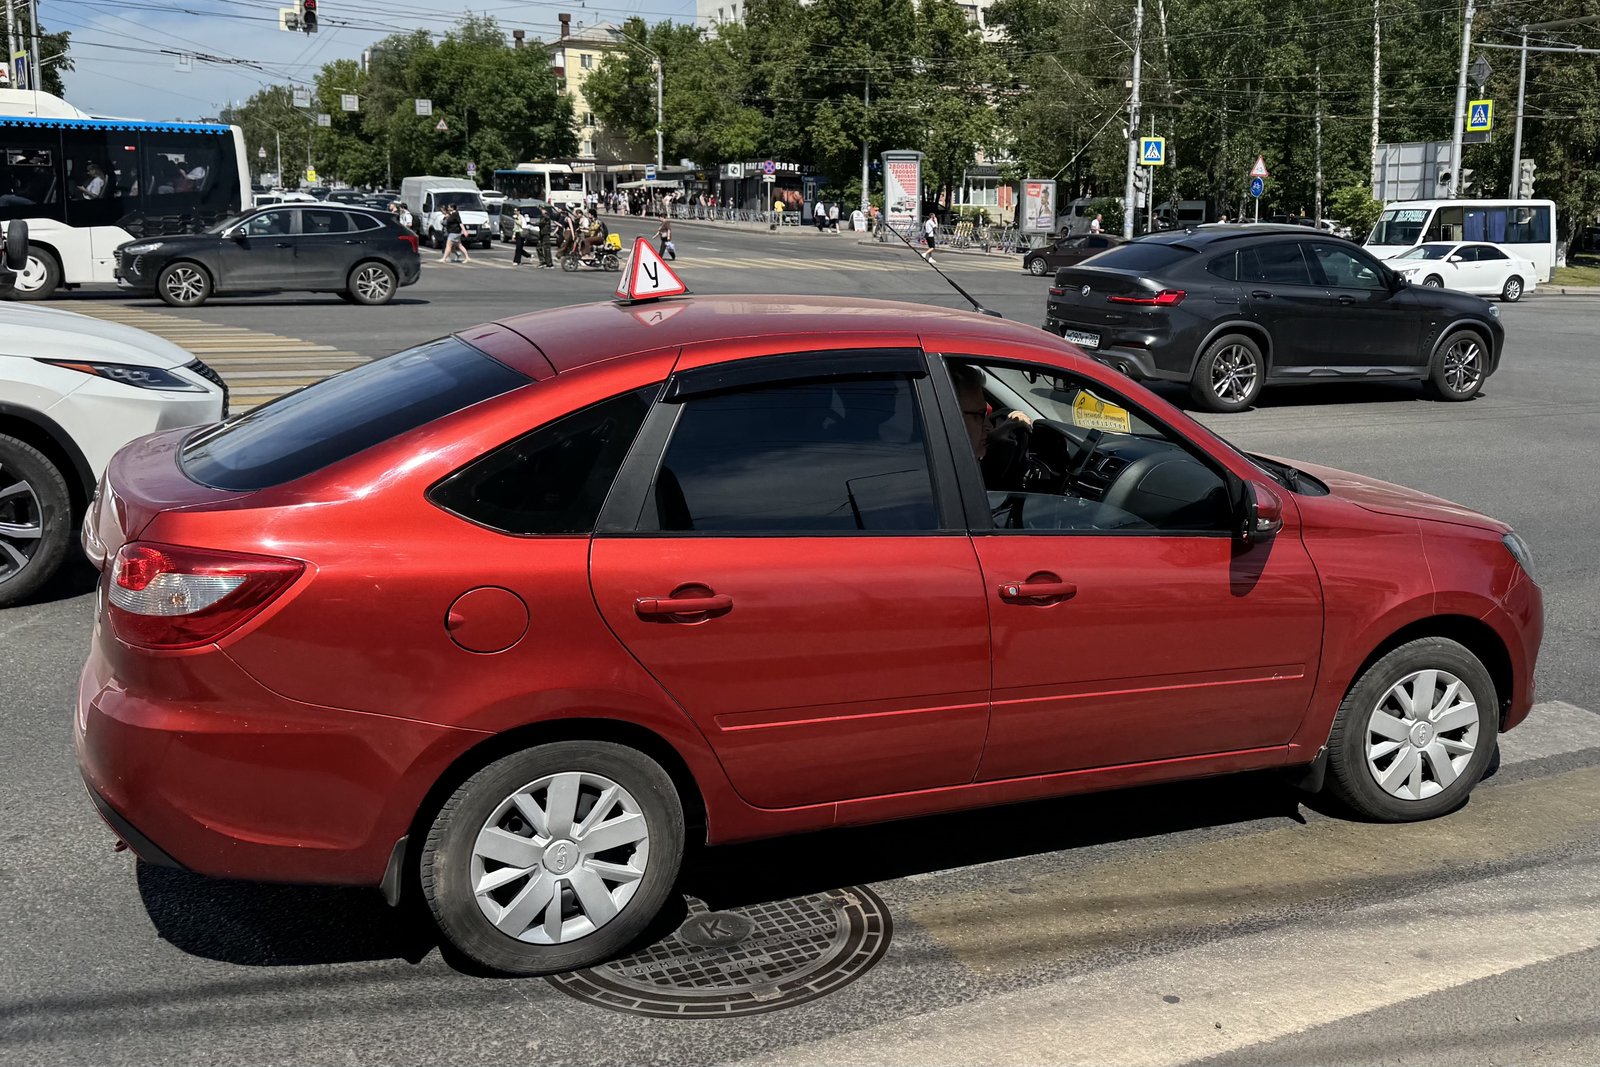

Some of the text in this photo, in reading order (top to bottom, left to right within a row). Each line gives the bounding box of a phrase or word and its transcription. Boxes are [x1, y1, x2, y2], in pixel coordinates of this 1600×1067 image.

[642, 261, 659, 288] У
[699, 918, 732, 939] К
[726, 958, 766, 971] 2024
